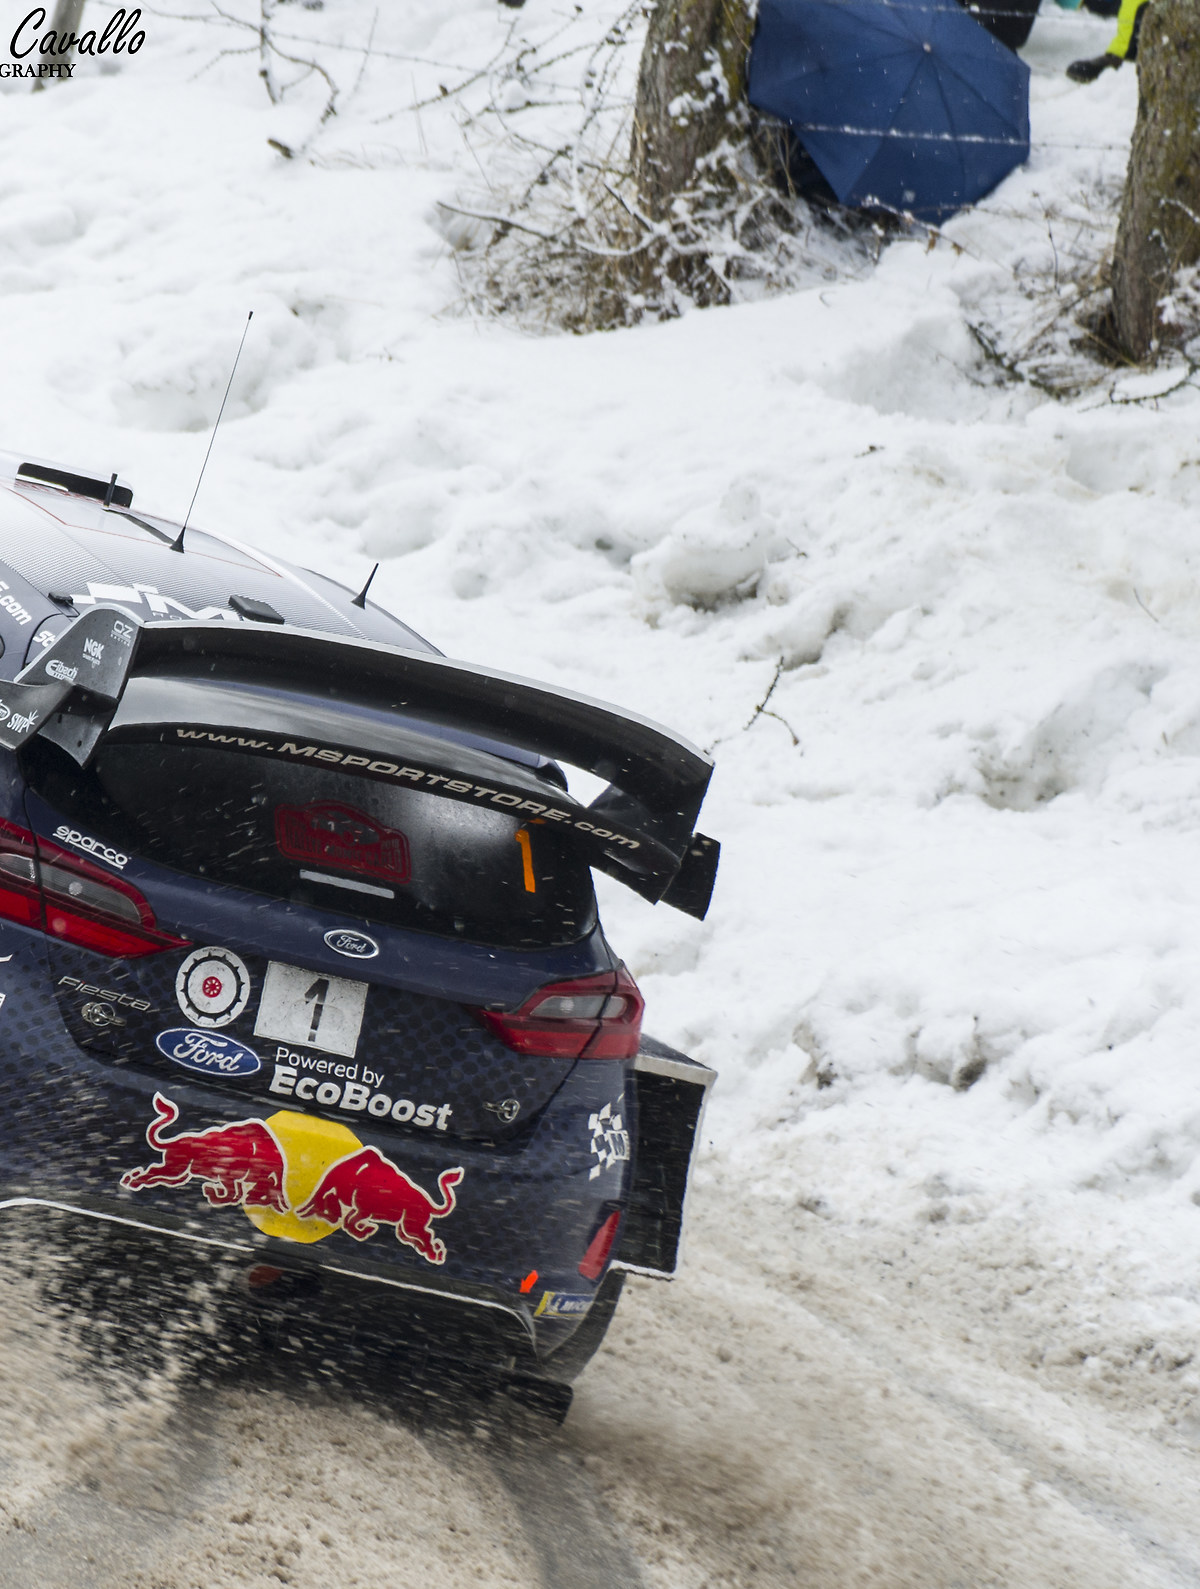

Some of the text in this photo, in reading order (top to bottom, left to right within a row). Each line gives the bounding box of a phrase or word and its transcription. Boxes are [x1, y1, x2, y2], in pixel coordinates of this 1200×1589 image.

[83, 638, 105, 660] NGK
[45, 659, 79, 680] Eibach
[176, 728, 641, 850] www.MSPORTSTORE.com
[53, 825, 128, 869] sparco
[336, 933, 369, 954] Ford
[58, 975, 151, 1011] Fiesta
[304, 978, 330, 1043] 1
[173, 1033, 244, 1072] Ford
[277, 1046, 385, 1088] Powered by
[268, 1065, 453, 1131] EcoBoost
